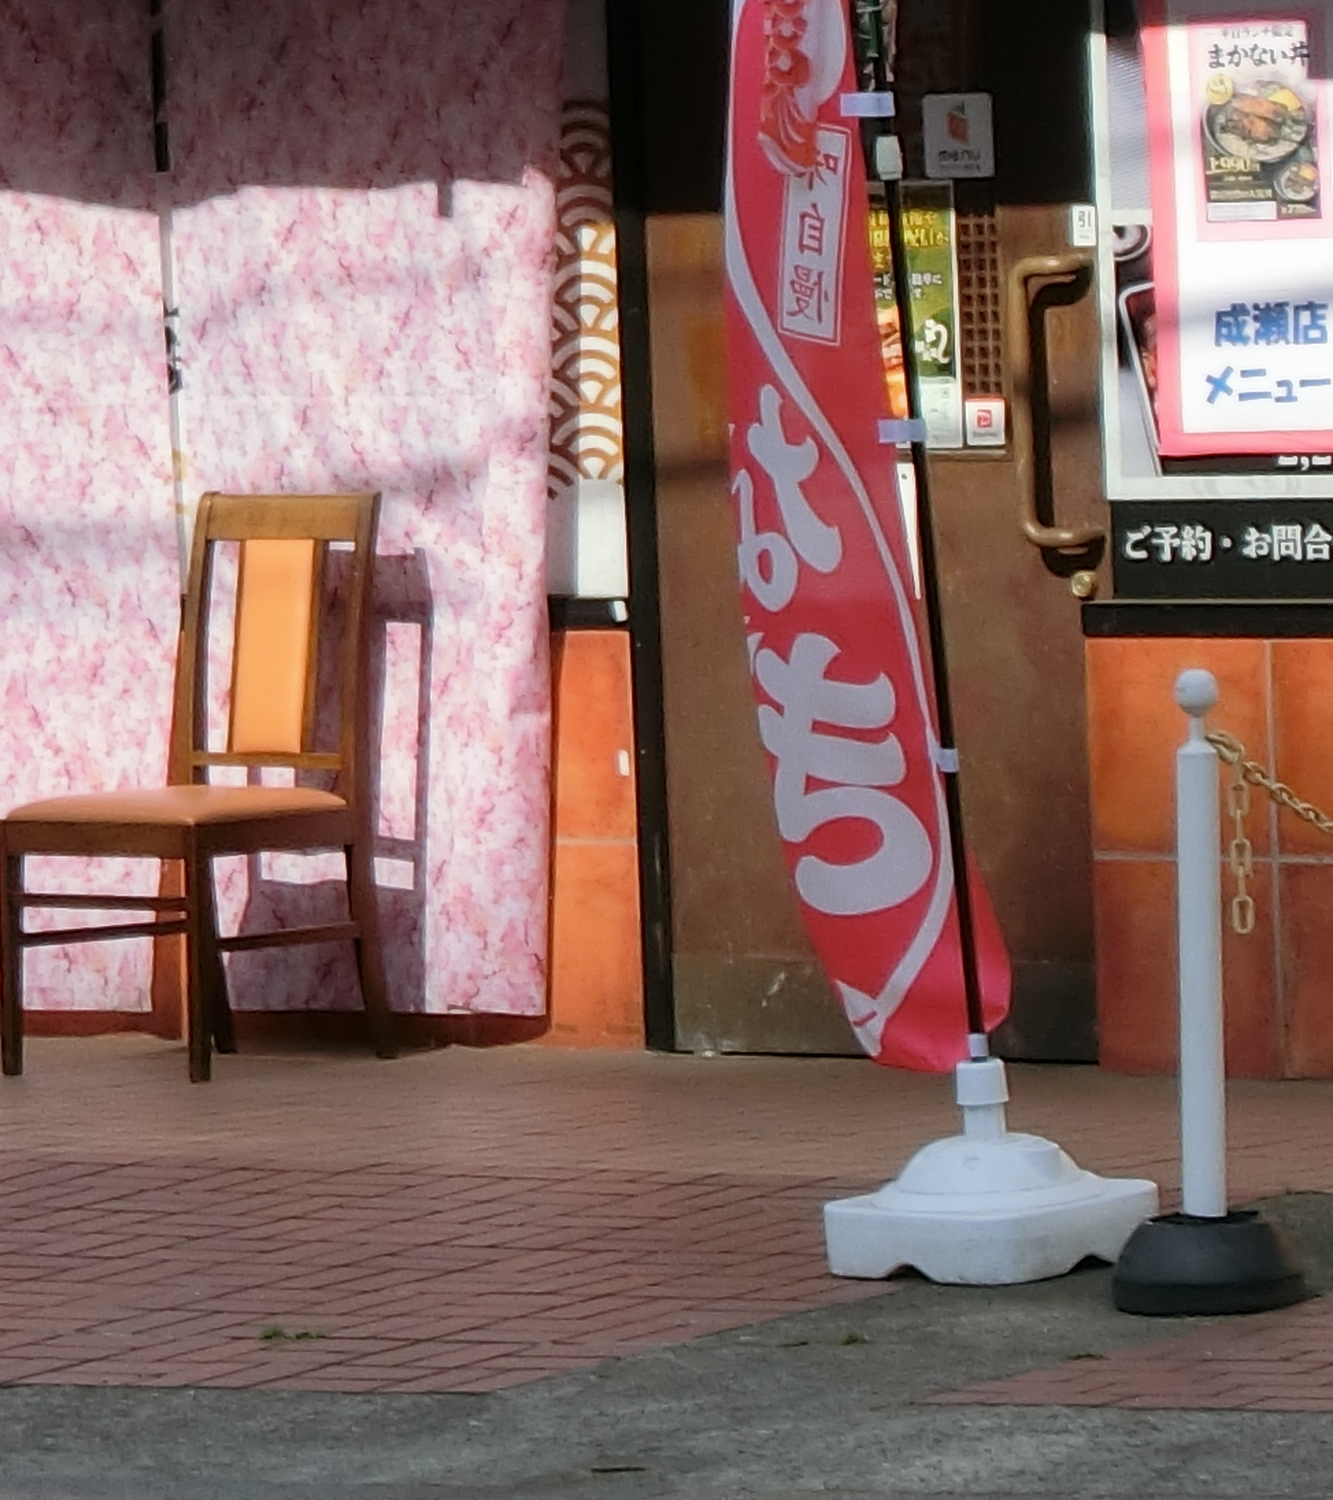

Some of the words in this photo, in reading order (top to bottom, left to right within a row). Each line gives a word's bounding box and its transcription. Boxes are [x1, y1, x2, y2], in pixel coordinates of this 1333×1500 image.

[1206, 41, 1312, 69] まかない丼
[1214, 300, 1329, 348] 成瀬店
[1205, 365, 1332, 406] メニュー
